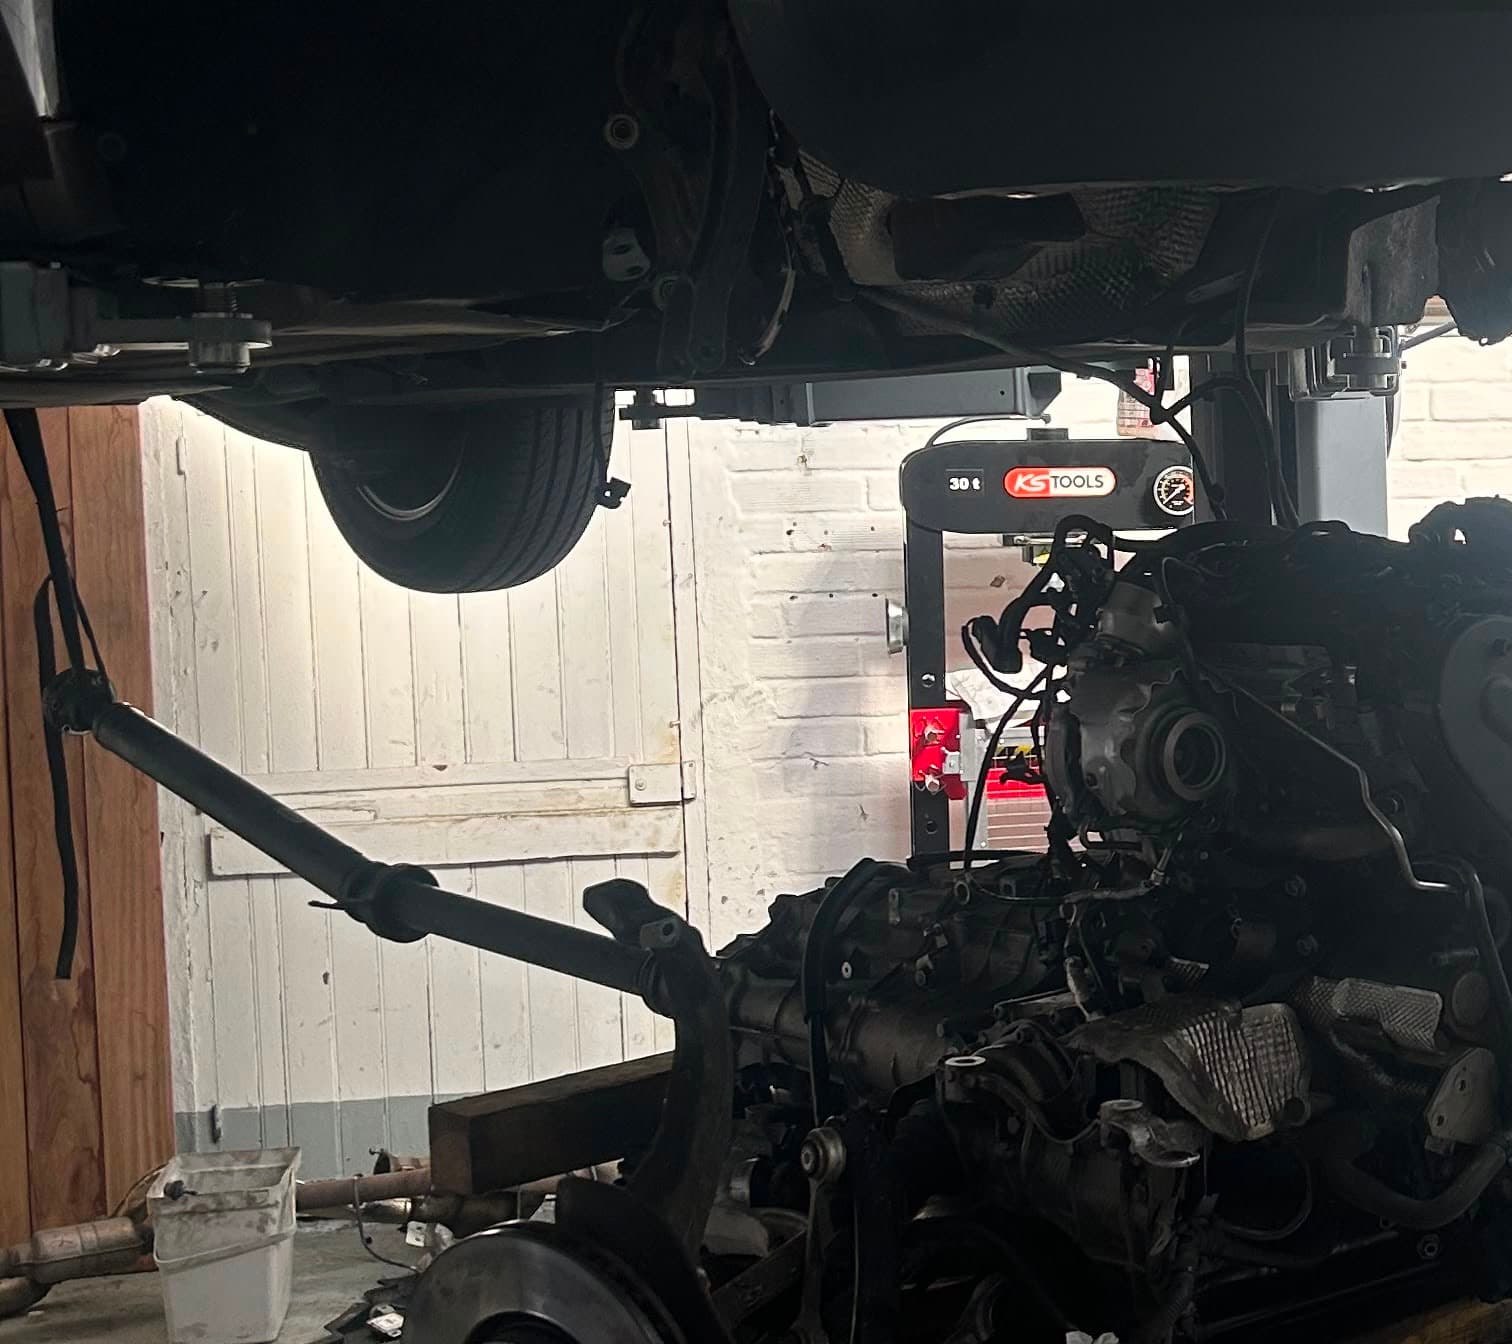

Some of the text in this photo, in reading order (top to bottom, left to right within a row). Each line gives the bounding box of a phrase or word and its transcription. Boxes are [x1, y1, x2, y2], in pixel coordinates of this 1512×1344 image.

[948, 476, 970, 491] 30
[1013, 473, 1104, 492] KS TOOLS
